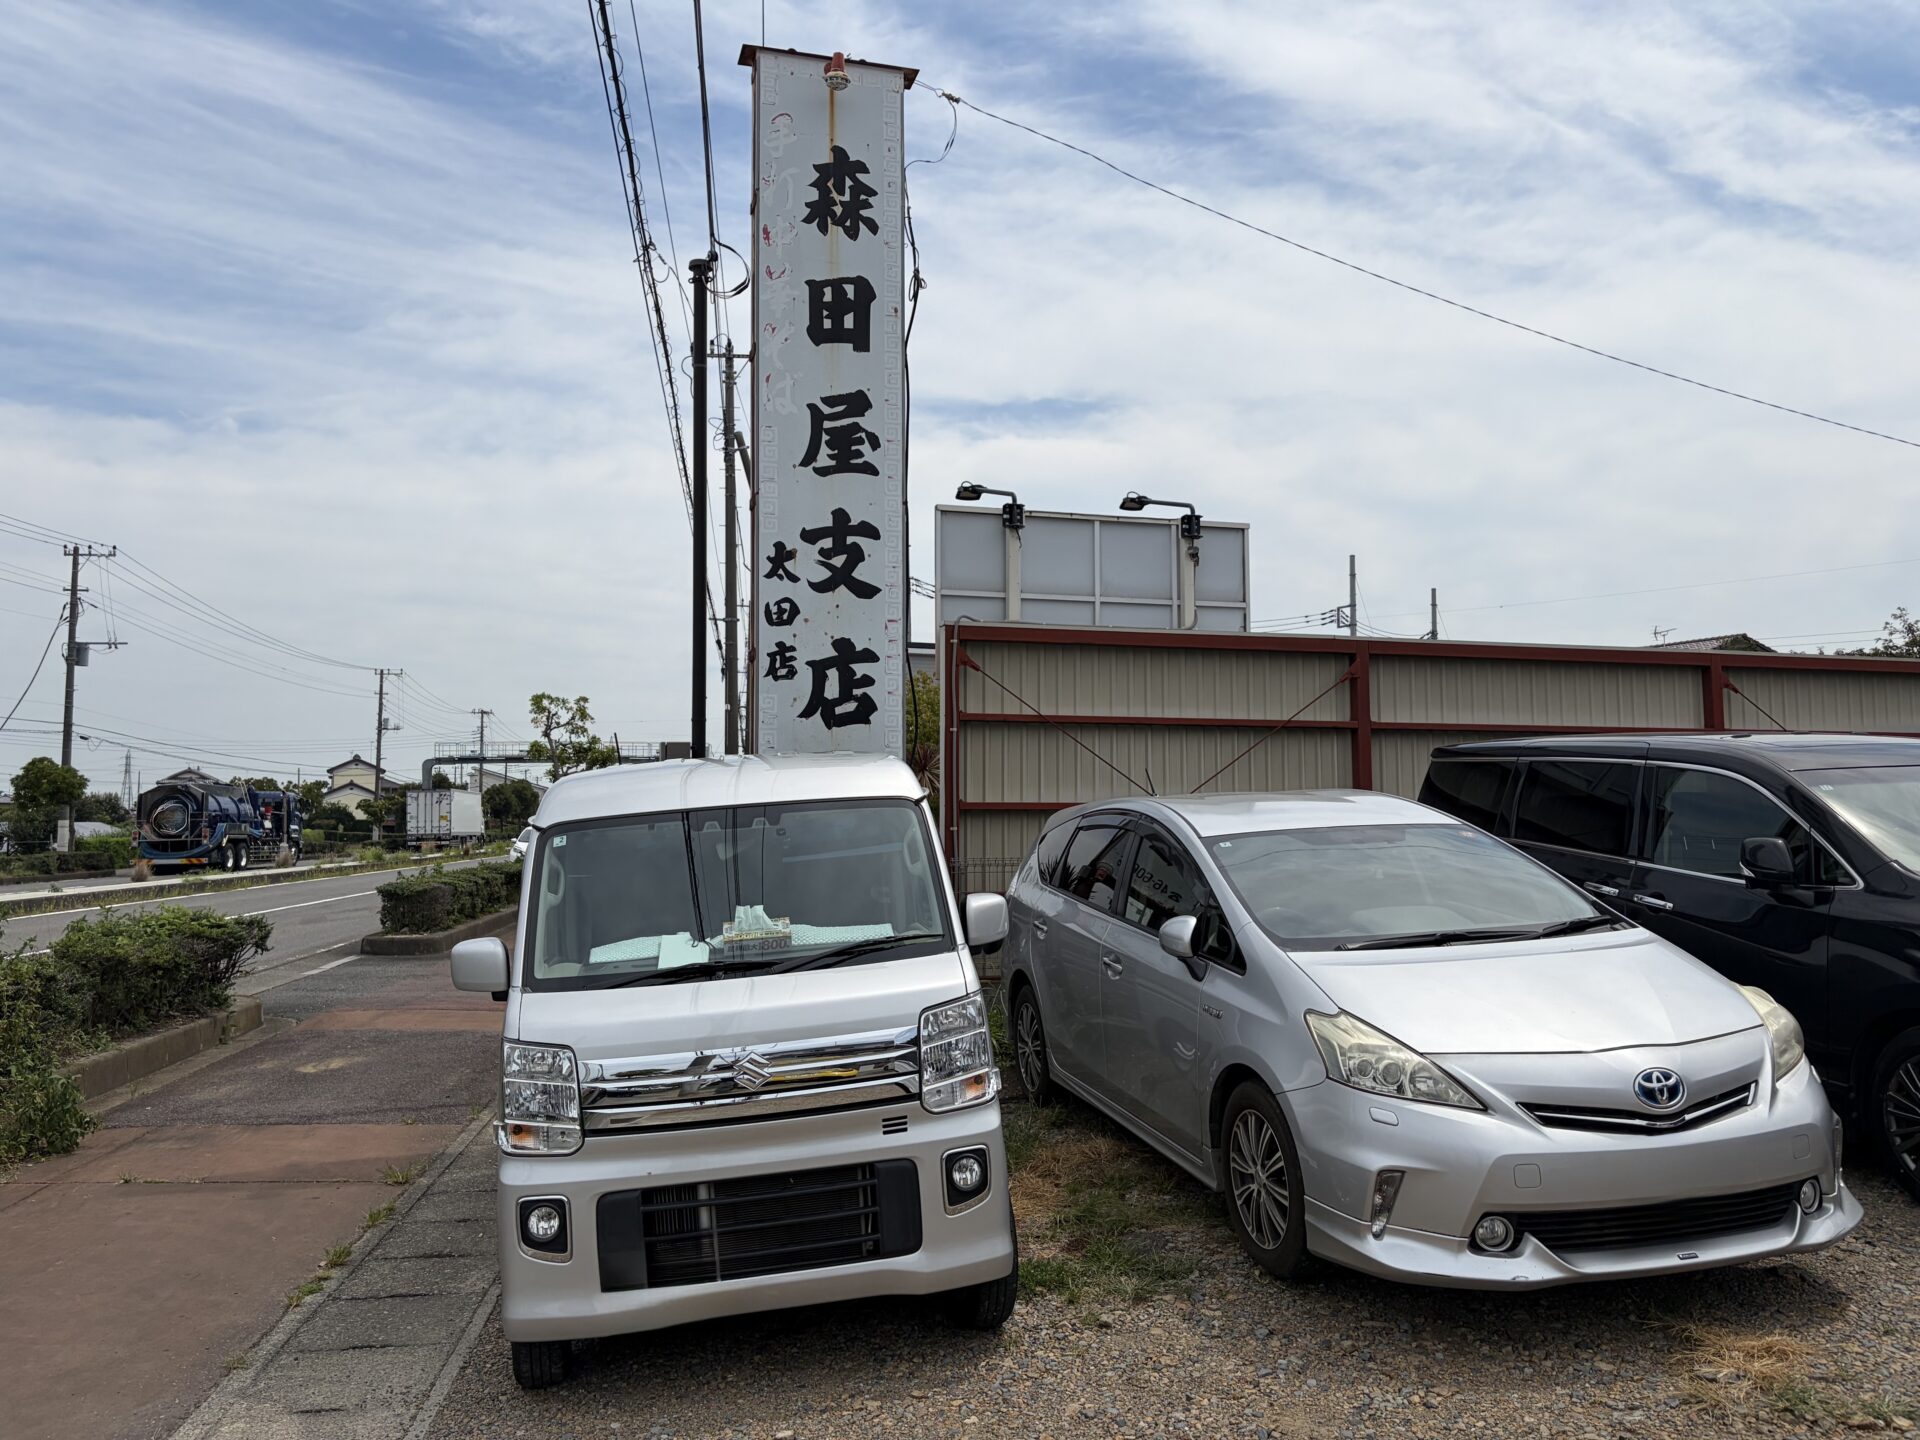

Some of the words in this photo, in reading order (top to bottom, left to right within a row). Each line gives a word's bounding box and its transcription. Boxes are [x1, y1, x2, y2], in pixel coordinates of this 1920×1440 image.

[763, 541, 801, 681] 太田店
[797, 145, 882, 730] 森田屋支店
